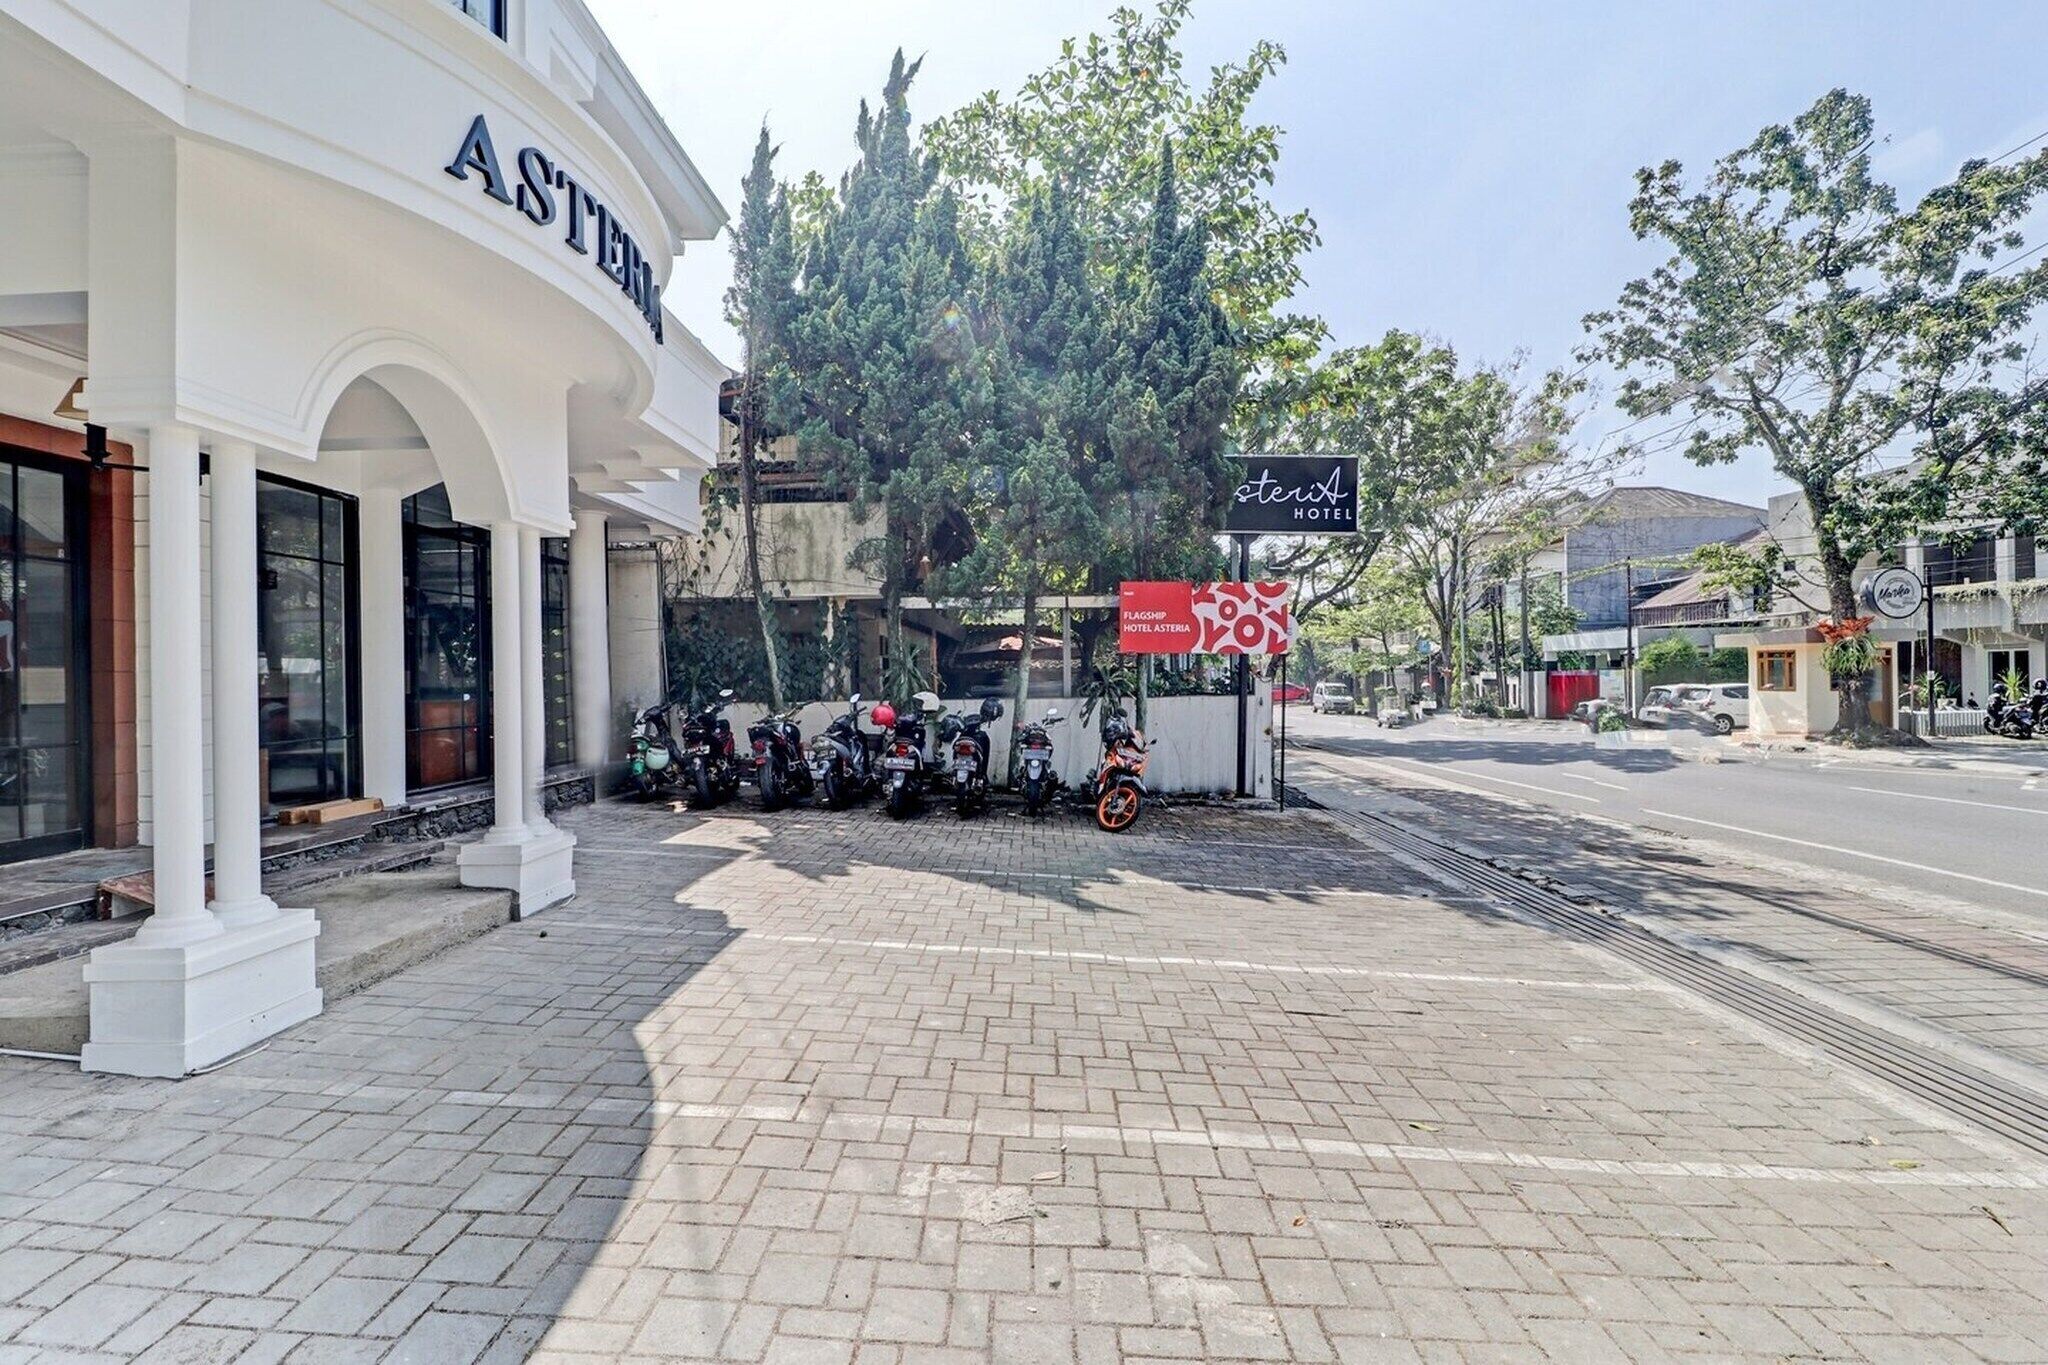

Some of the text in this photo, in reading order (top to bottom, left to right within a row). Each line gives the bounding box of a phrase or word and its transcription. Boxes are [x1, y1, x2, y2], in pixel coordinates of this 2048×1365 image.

[1233, 466, 1348, 505] steriA
[1294, 508, 1351, 520] HOTEL
[1123, 611, 1167, 620] FLAGSHIP
[1123, 624, 1190, 632] HOTEL ASTERIA
